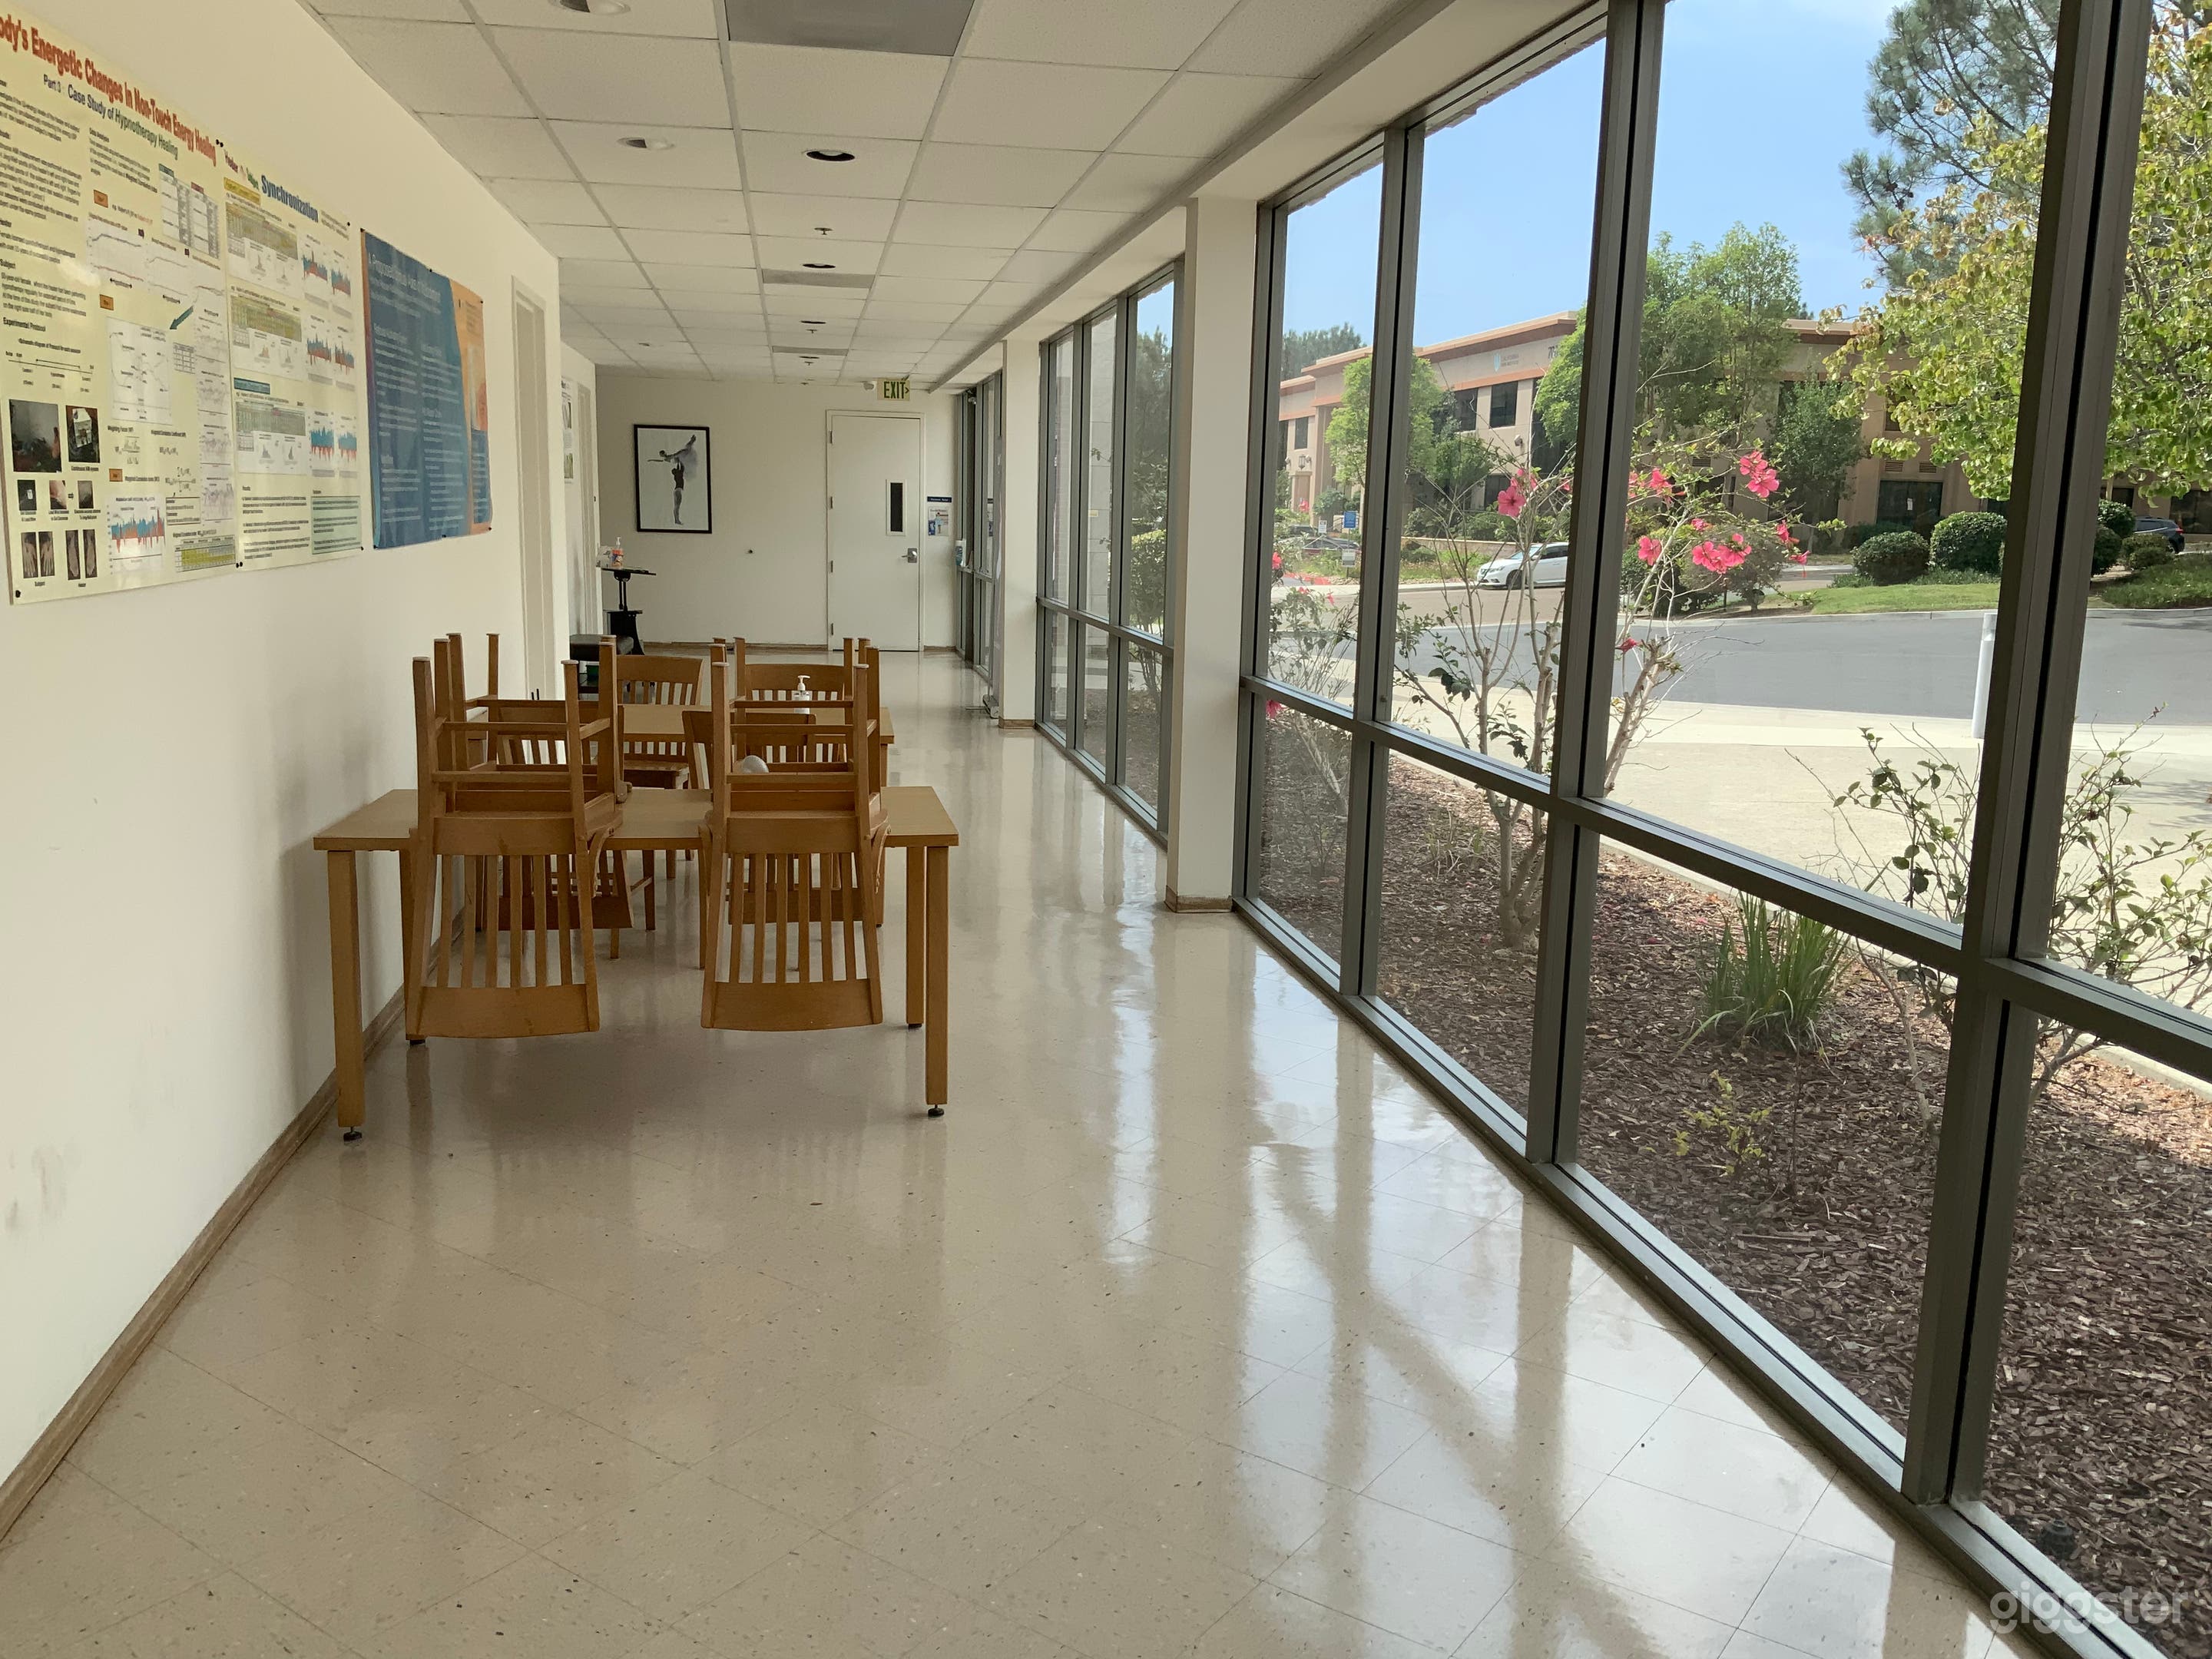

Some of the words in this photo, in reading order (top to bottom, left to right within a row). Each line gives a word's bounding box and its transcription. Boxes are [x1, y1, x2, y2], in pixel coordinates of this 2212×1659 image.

[31, 27, 83, 80] Energetic
[84, 58, 124, 104] Changes
[172, 113, 194, 152] Energy
[194, 127, 216, 167] Healing
[43, 74, 56, 91] Part
[68, 84, 86, 105] Case
[87, 94, 106, 119] Study
[107, 108, 114, 120] of
[115, 108, 157, 147] Hypnotherapy
[158, 134, 178, 160] Healing
[261, 174, 319, 223] Synchronization
[883, 381, 906, 399] EXIT
